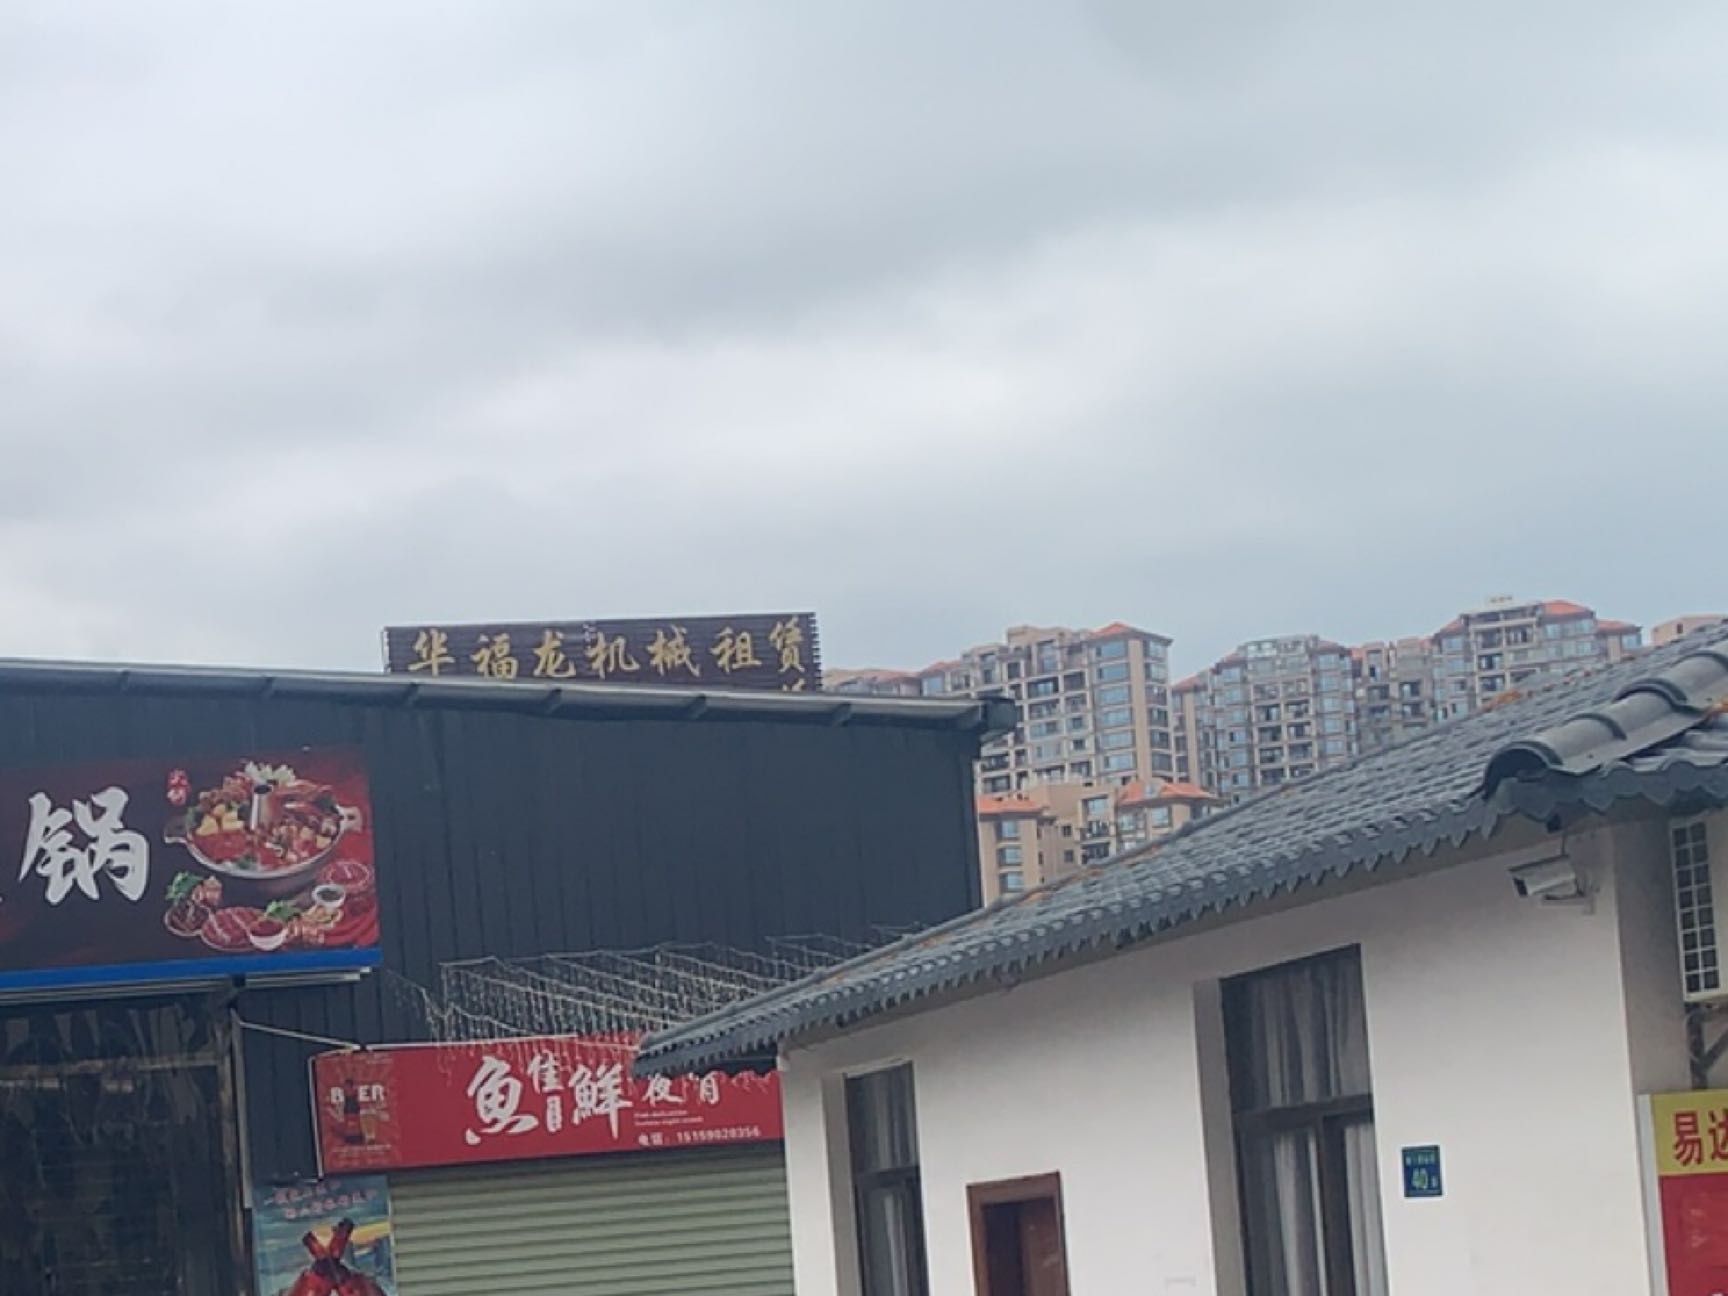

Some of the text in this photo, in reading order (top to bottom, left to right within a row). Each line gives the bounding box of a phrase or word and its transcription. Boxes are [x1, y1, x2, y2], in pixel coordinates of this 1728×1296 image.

[408, 615, 806, 681] 华福龙机械租赁
[330, 1084, 386, 1105] BER
